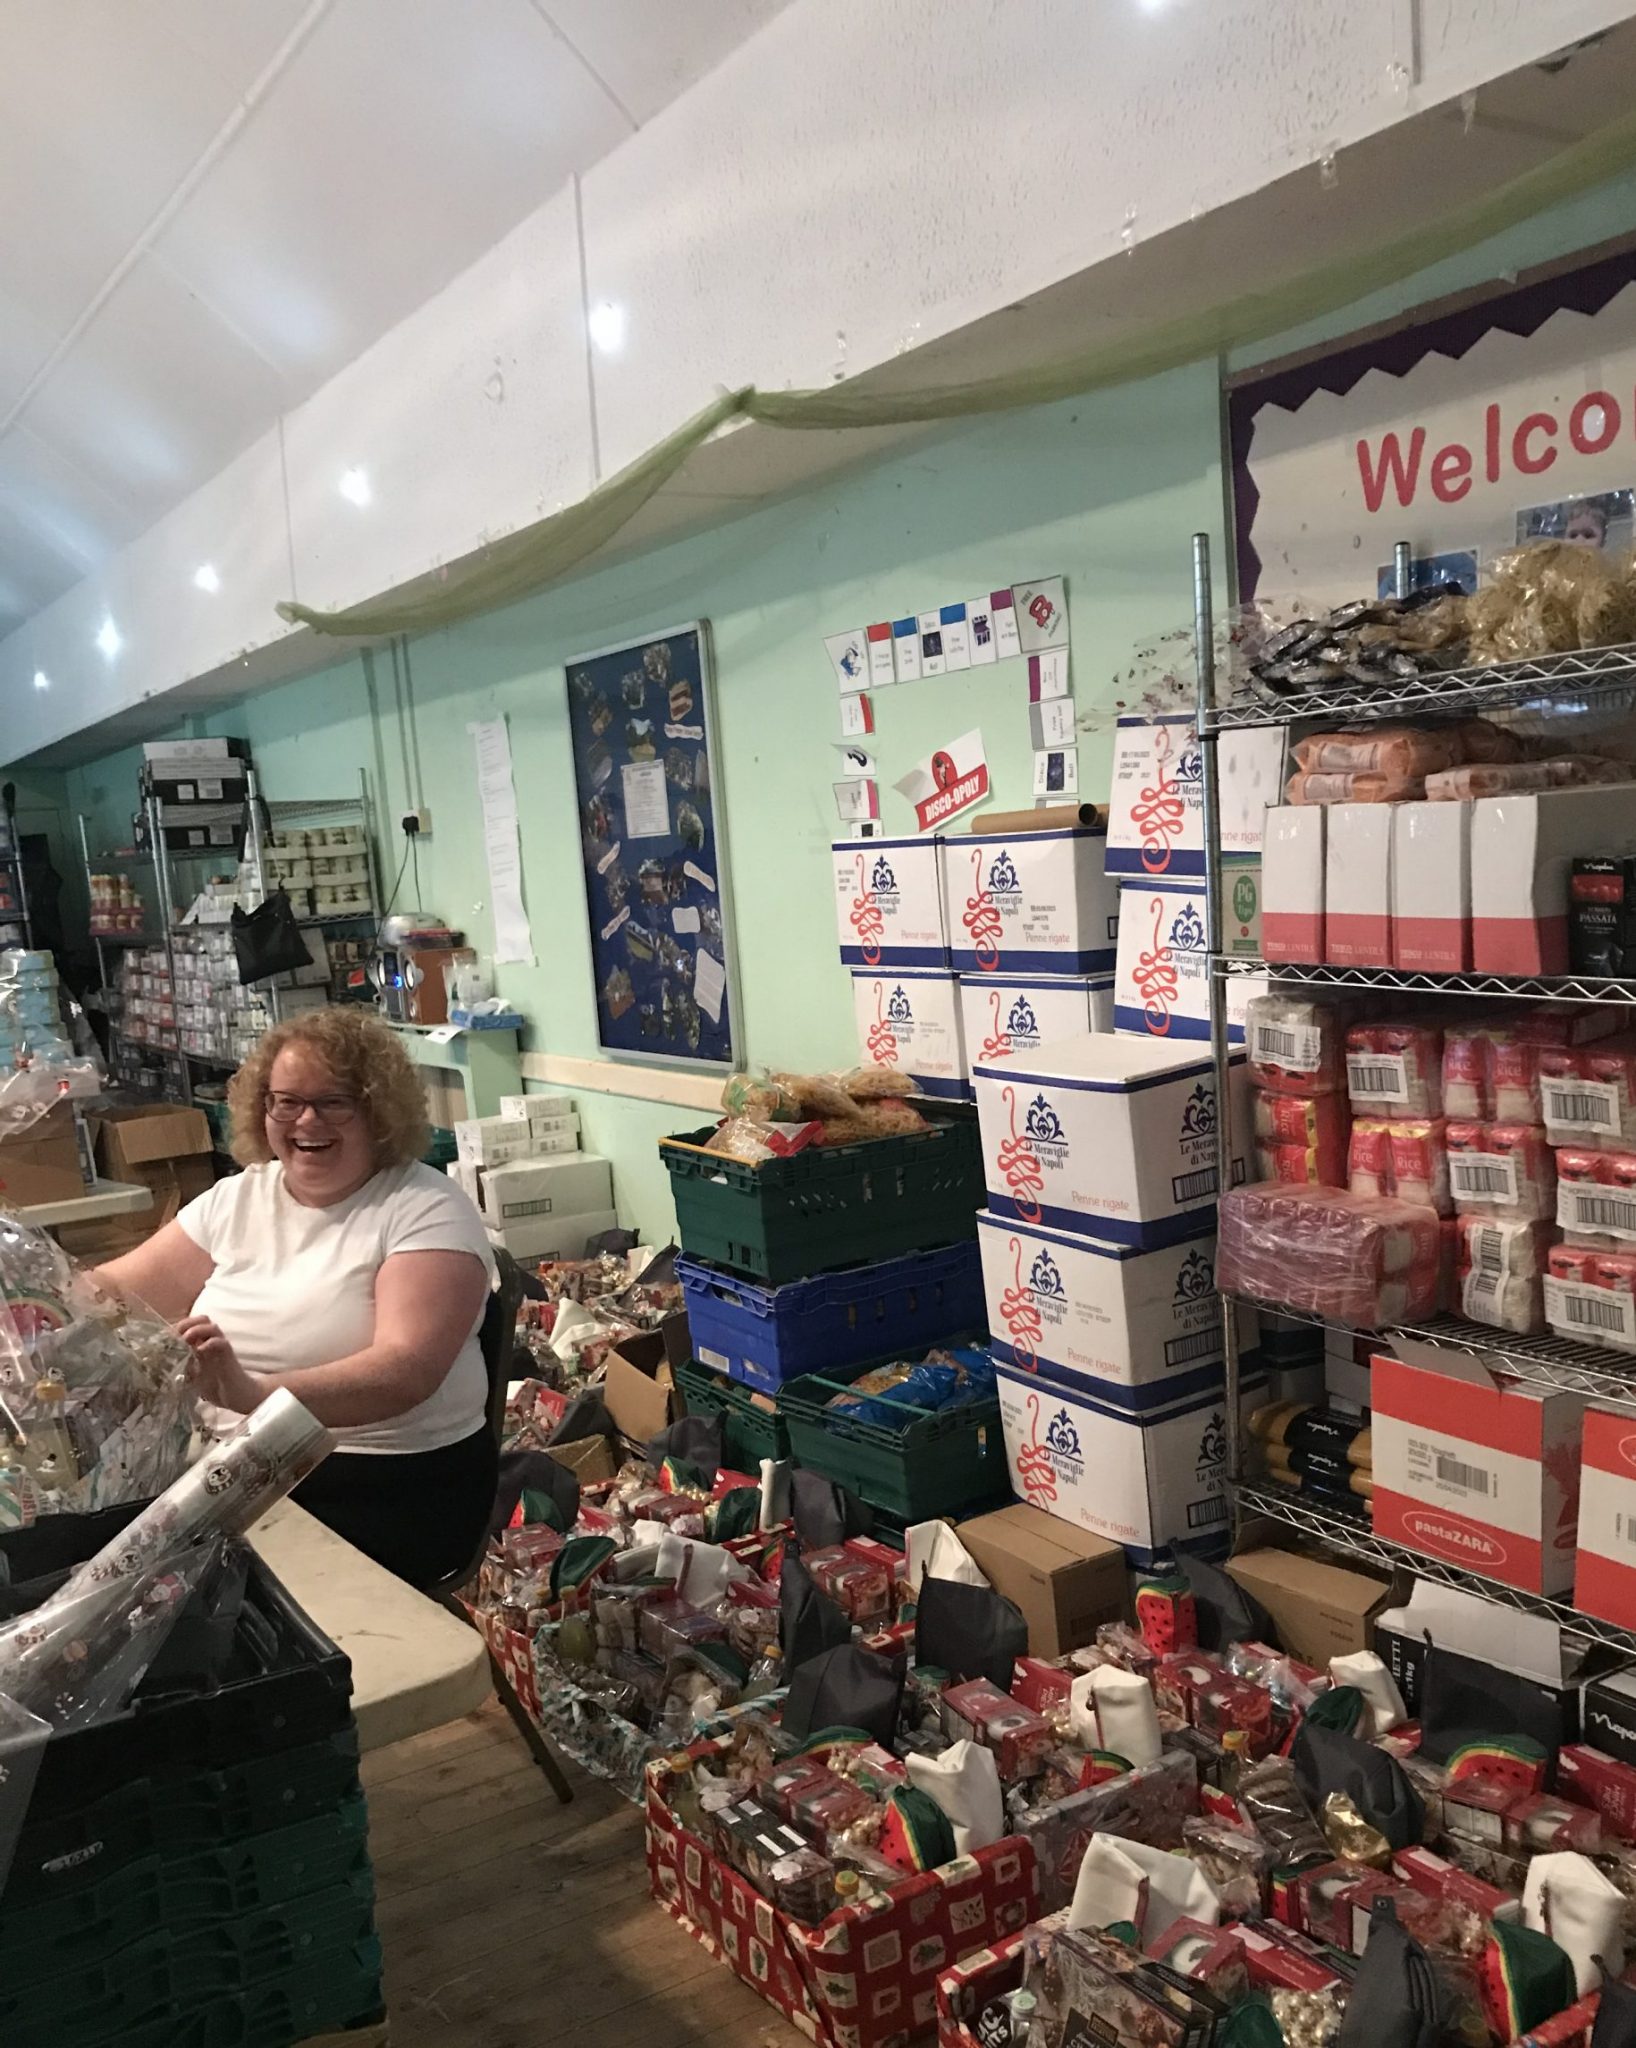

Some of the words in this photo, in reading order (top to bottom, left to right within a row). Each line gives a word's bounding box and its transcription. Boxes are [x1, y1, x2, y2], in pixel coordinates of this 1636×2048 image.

[1356, 383, 1636, 513] Welco
[925, 774, 979, 823] DISCO-OPOLY
[1187, 798, 1203, 810] Nap
[1220, 831, 1240, 842] nne
[1237, 882, 1253, 903] PG
[1579, 913, 1618, 924] PASSATA
[1174, 953, 1206, 967] Meravigli
[1497, 1062, 1522, 1077] Rice
[1034, 1142, 1070, 1159] Meraviglie
[1180, 1144, 1190, 1156] Le
[1191, 1139, 1216, 1151] Merav
[1041, 1156, 1064, 1171] Napoli
[1190, 1154, 1199, 1165] di
[1200, 1151, 1216, 1163] Nap
[1397, 1156, 1421, 1170] Rice
[1071, 1190, 1101, 1207] Penne
[1102, 1199, 1130, 1212] rigate
[1036, 1294, 1069, 1315] Meraviglie
[1041, 1310, 1063, 1325] Napoli
[1067, 1347, 1095, 1366] Penne
[1095, 1359, 1122, 1374] rigate
[1052, 1454, 1085, 1477] Meraviglie
[1080, 1507, 1108, 1528] Penne
[1109, 1521, 1140, 1538] rigate
[1415, 1520, 1492, 1555] pastaZARA
